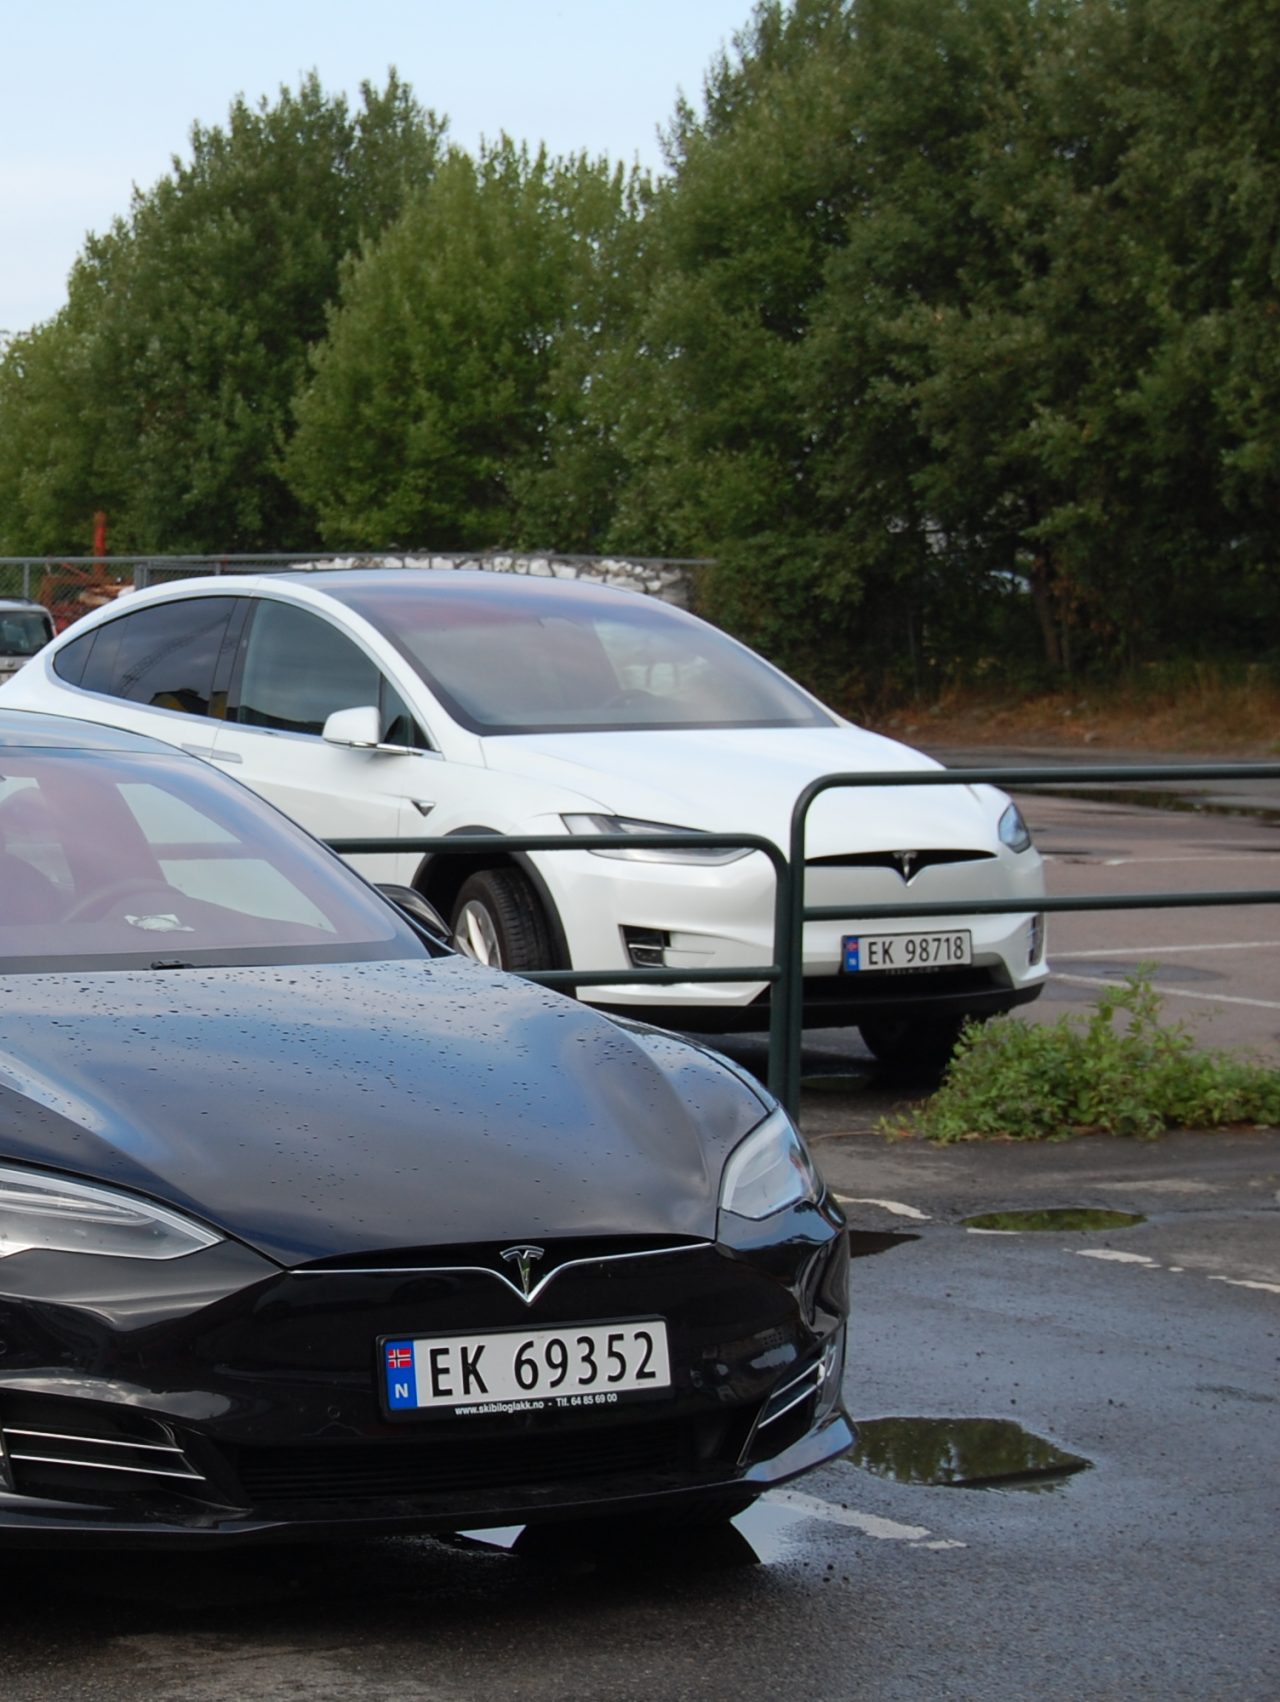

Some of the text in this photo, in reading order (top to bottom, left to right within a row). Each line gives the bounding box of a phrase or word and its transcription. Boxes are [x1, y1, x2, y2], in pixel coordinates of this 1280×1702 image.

[868, 936, 964, 965] EK 98718
[428, 1331, 657, 1398] EK 69352
[394, 1382, 409, 1400] N
[571, 1395, 581, 1406] 64
[595, 1393, 606, 1403] 69
[607, 1392, 618, 1402] 00
